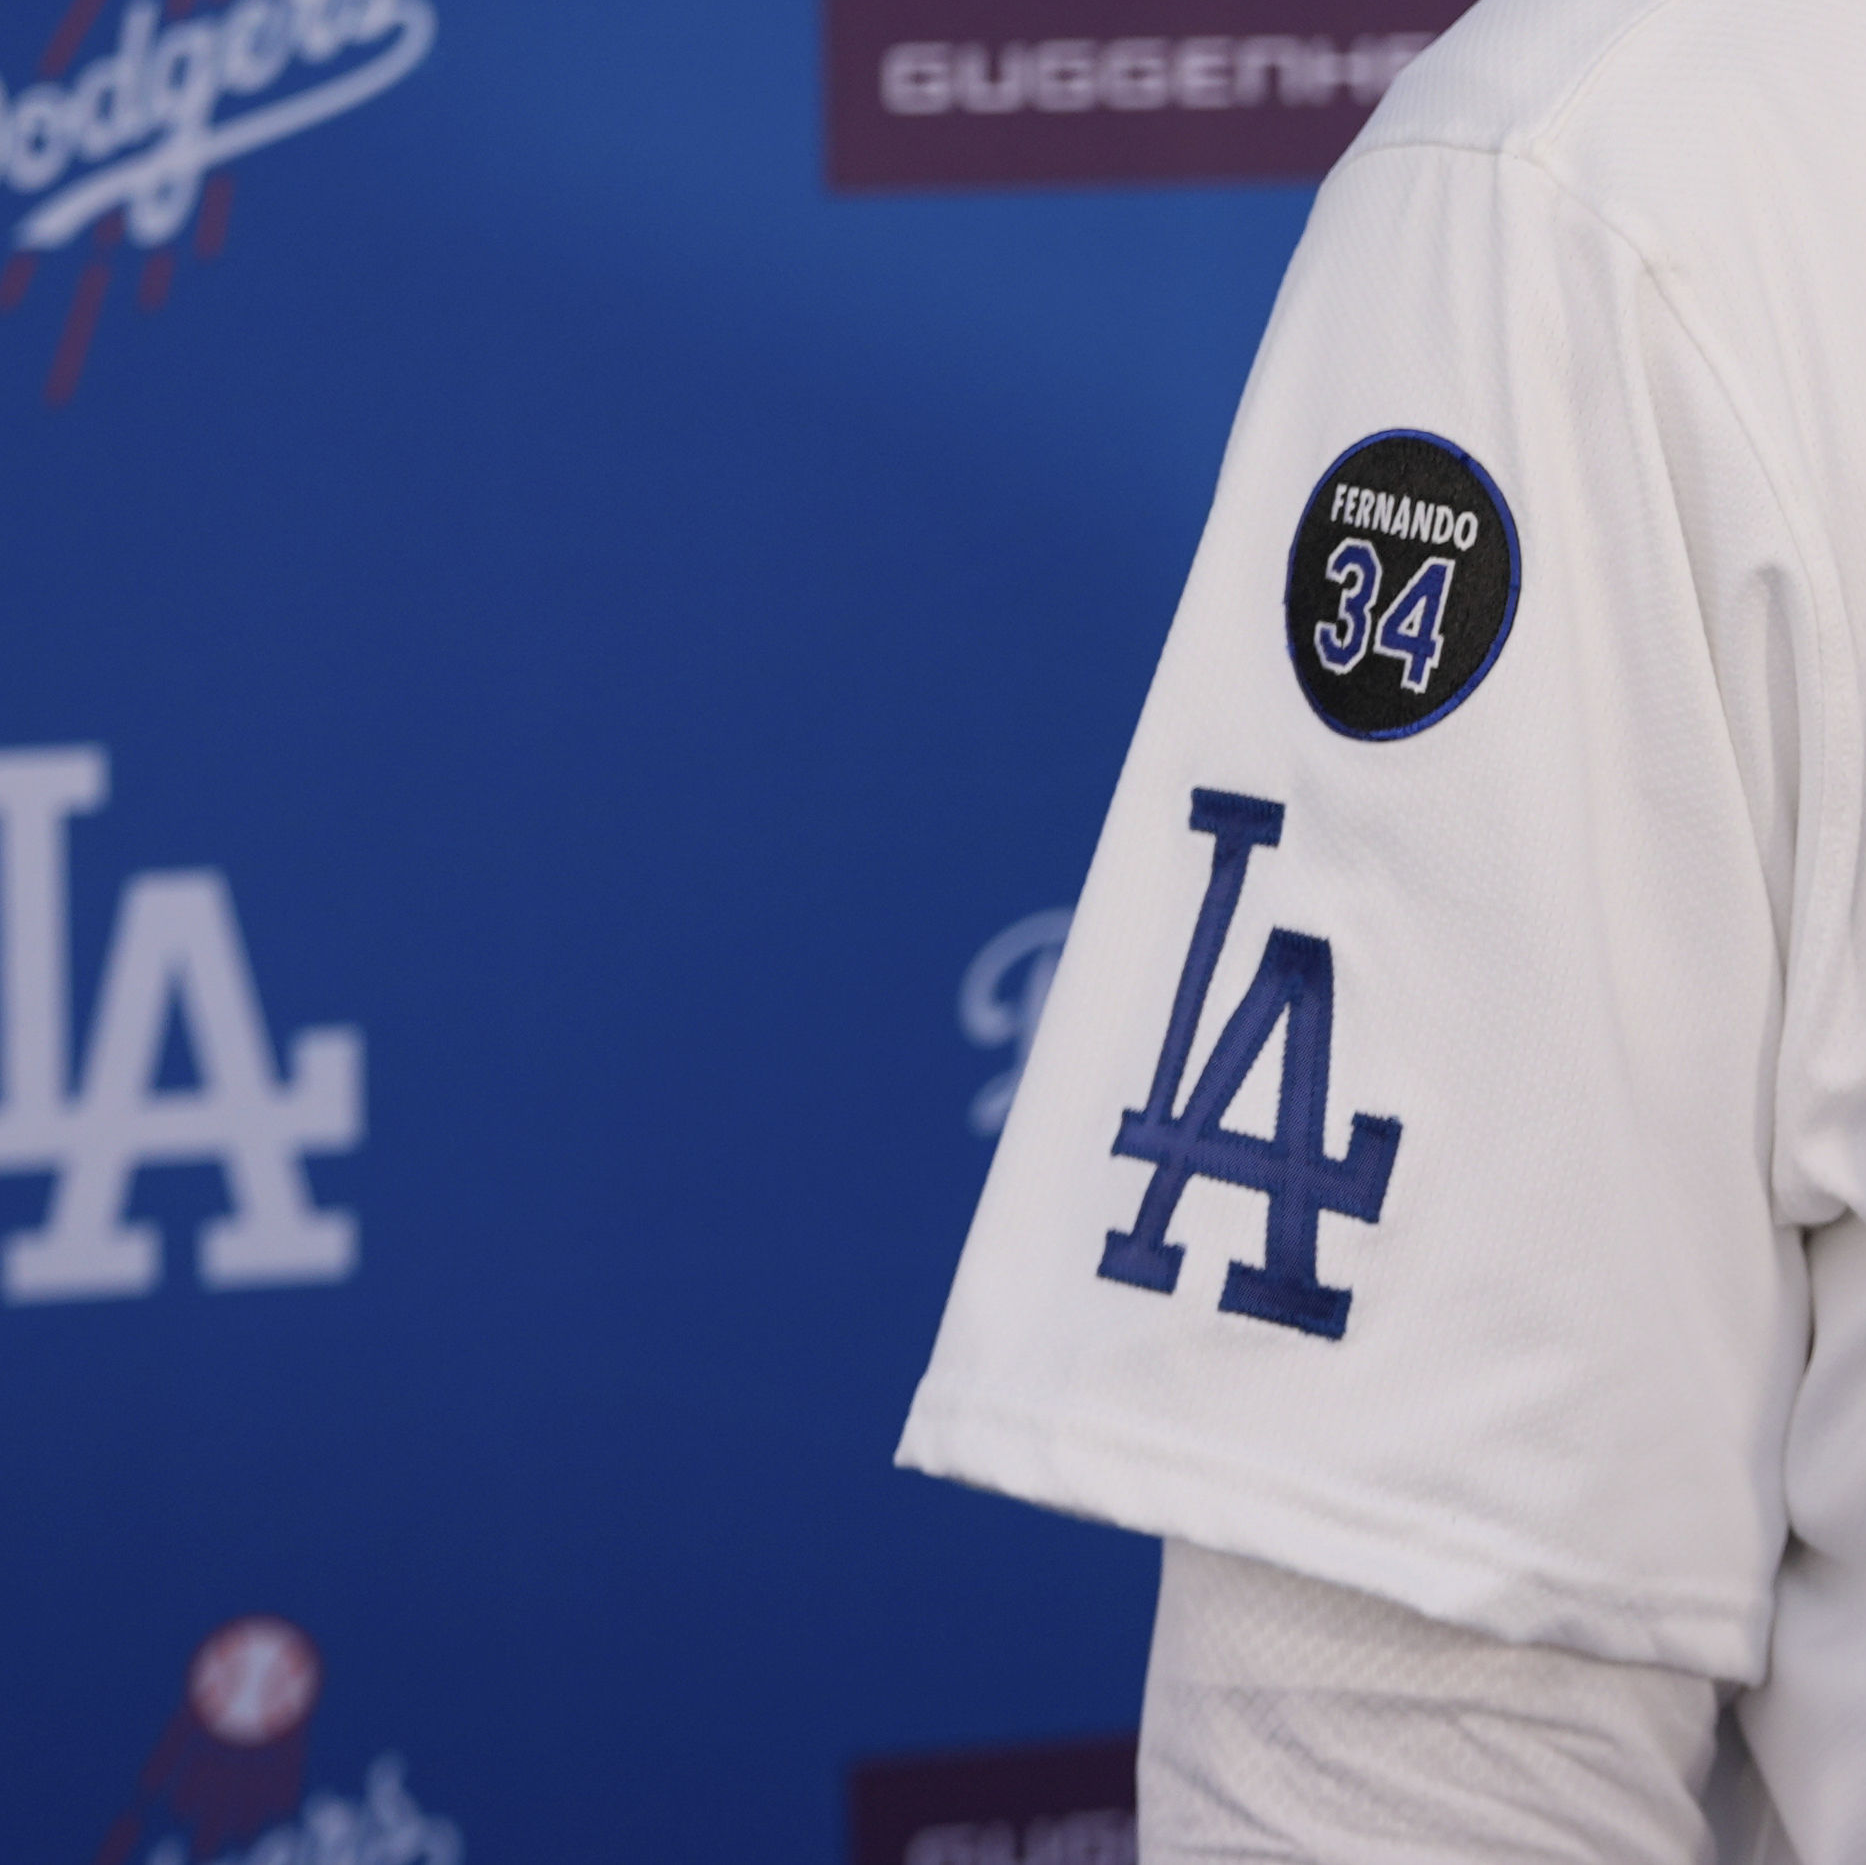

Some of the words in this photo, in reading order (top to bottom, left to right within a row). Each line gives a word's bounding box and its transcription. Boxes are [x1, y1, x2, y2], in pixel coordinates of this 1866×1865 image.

[1331, 484, 1478, 551] FERNANDO
[1314, 537, 1455, 694] 34
[1097, 788, 1402, 1341] LA
